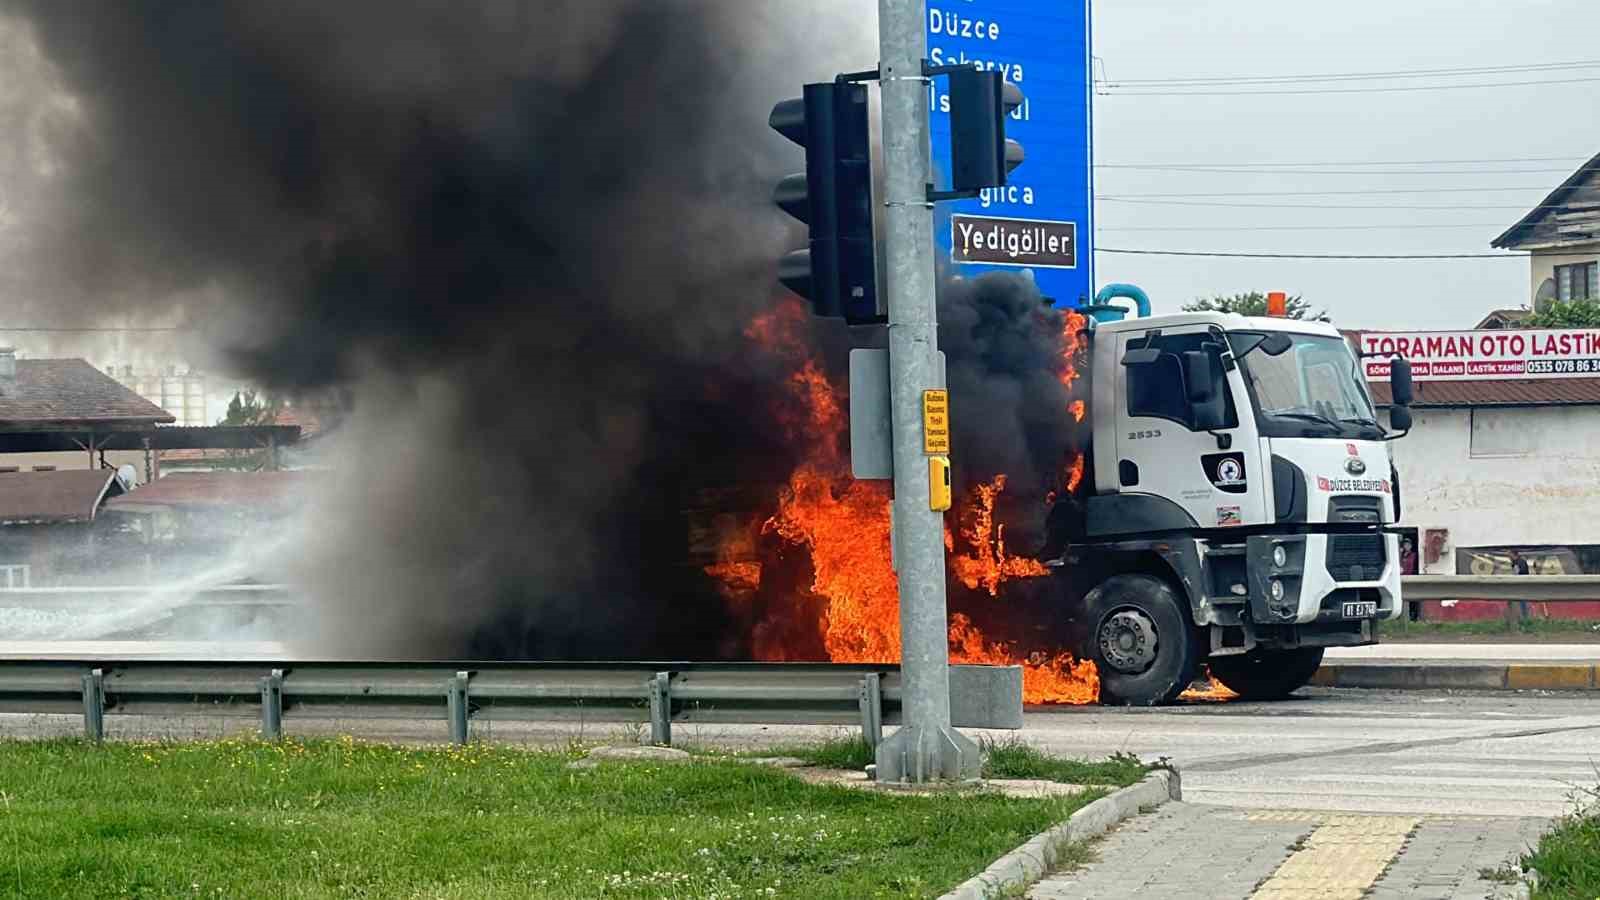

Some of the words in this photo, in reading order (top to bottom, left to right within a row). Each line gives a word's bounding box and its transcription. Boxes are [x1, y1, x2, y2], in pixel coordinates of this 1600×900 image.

[930, 8, 1000, 40] Düzce
[958, 222, 1070, 257] Yedigöller
[1366, 336, 1474, 359] TORAMAN
[1479, 335, 1525, 357] OTO
[1527, 360, 1553, 373] 0535
[1555, 360, 1574, 372] 078
[1576, 360, 1590, 372] 86
[1128, 429, 1162, 440] 2533
